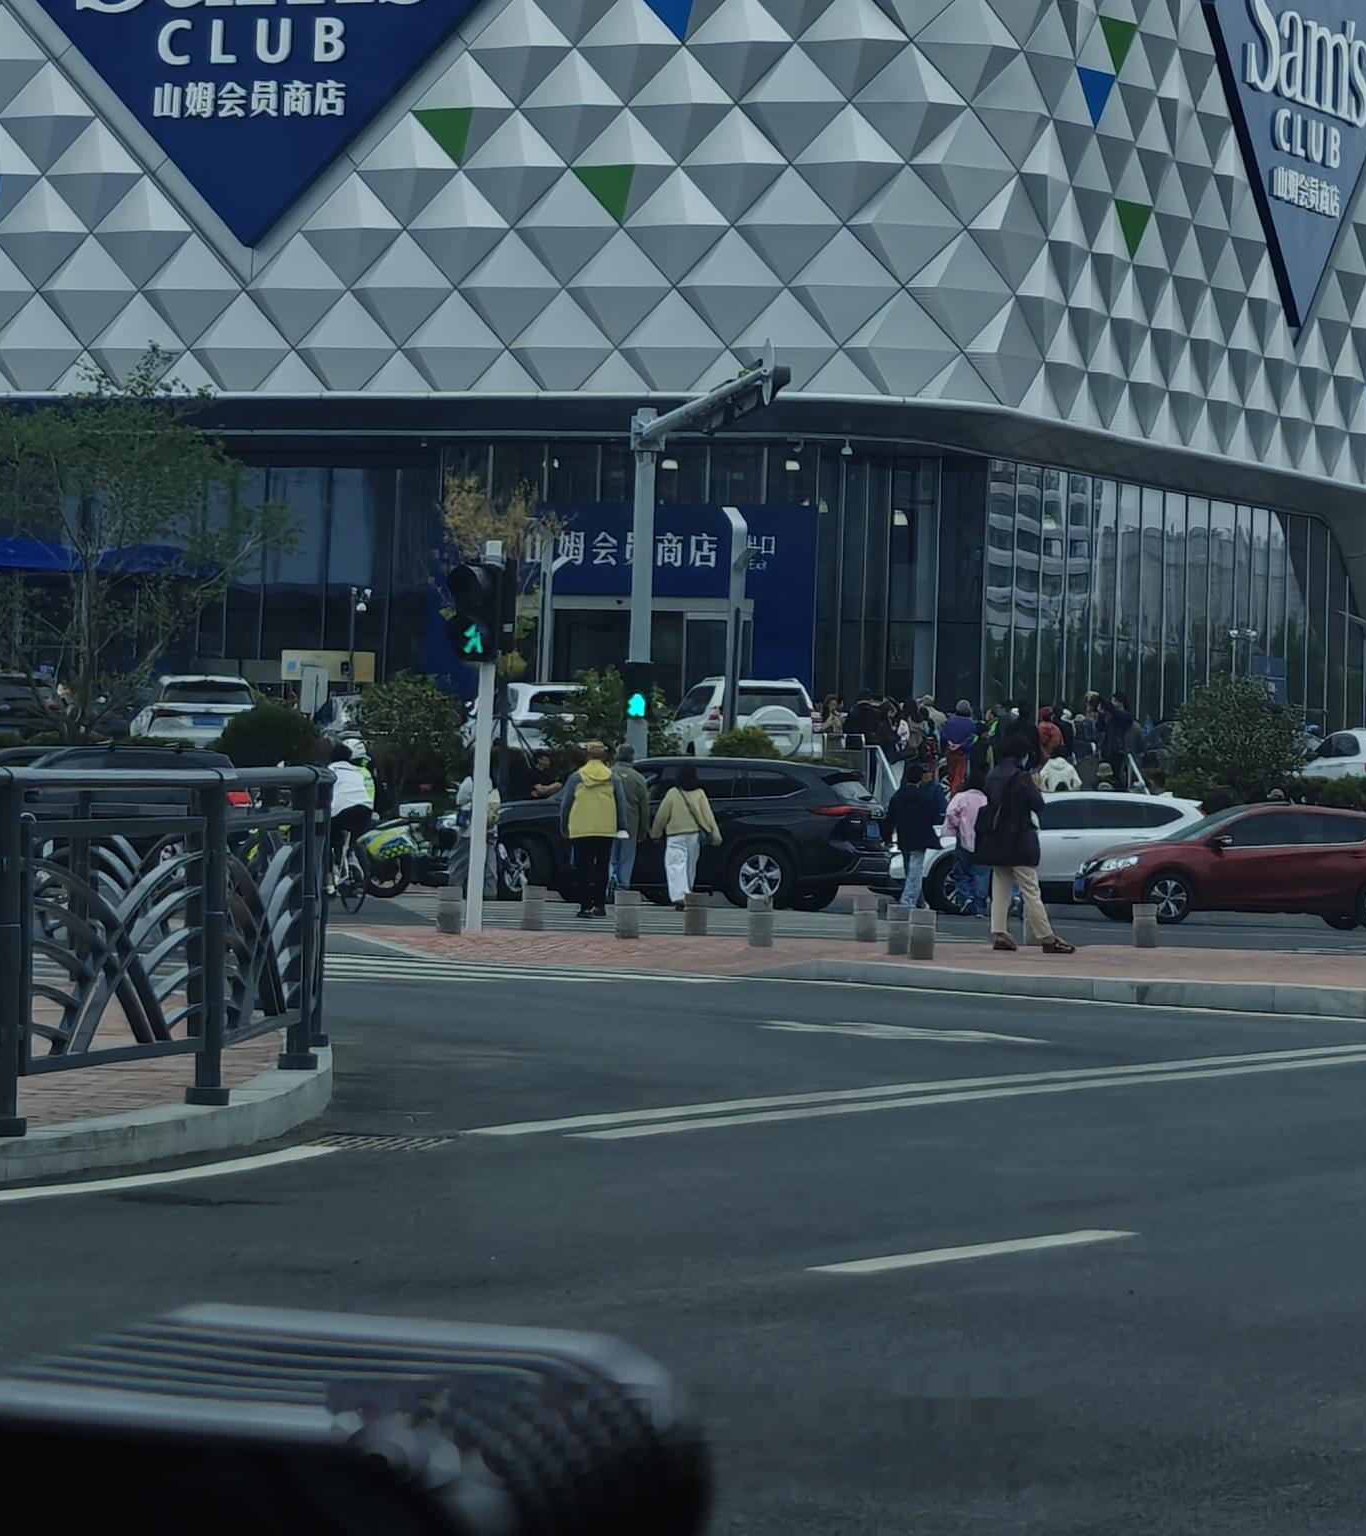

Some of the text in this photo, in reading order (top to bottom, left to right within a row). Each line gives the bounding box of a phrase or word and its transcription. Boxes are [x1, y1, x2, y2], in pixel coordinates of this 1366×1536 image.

[157, 17, 346, 65] CLUB
[153, 79, 347, 118] 山姆会员商店
[1272, 108, 1341, 169] CLUB
[1270, 166, 1341, 219] 山姆会员商店
[524, 530, 718, 568] 山姆会商店
